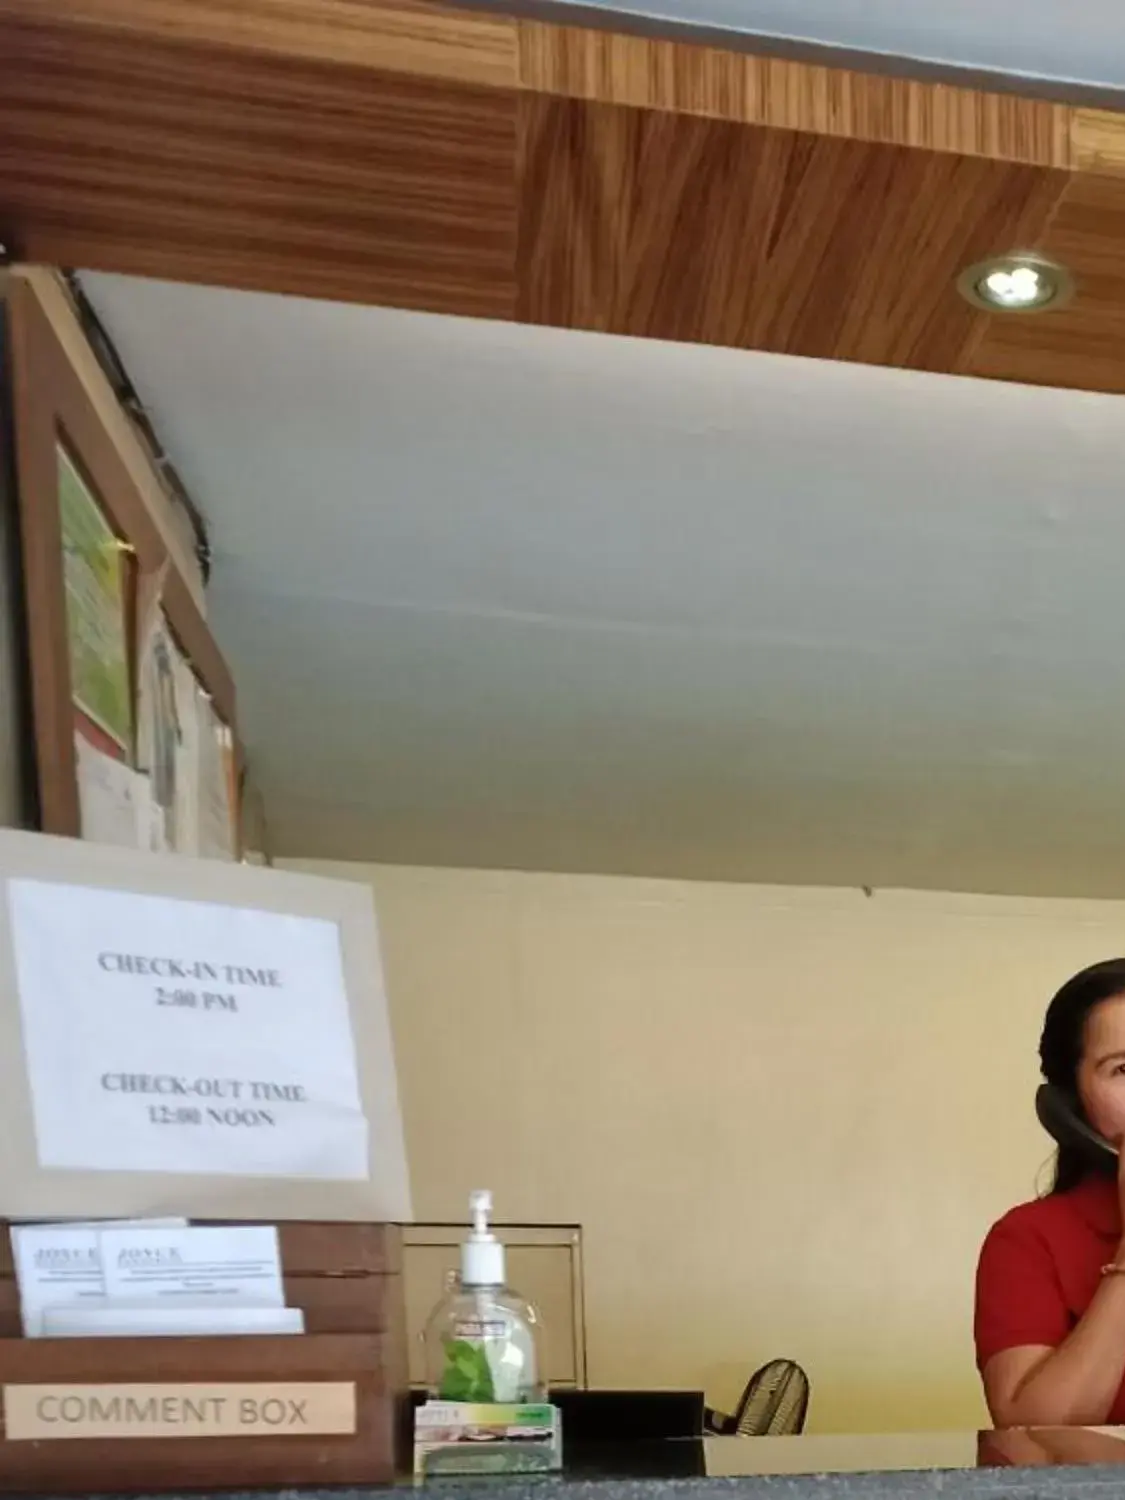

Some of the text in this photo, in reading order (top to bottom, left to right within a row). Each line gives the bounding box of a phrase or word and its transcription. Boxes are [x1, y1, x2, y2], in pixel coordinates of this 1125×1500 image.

[98, 952, 283, 989] CHECK-IN TIME
[155, 986, 239, 1014] 2:00 PM
[101, 1072, 308, 1103] CHECK-OUT TIME
[147, 1104, 276, 1127] 12:00 NOON
[35, 1394, 308, 1426] COMMENT BOX
